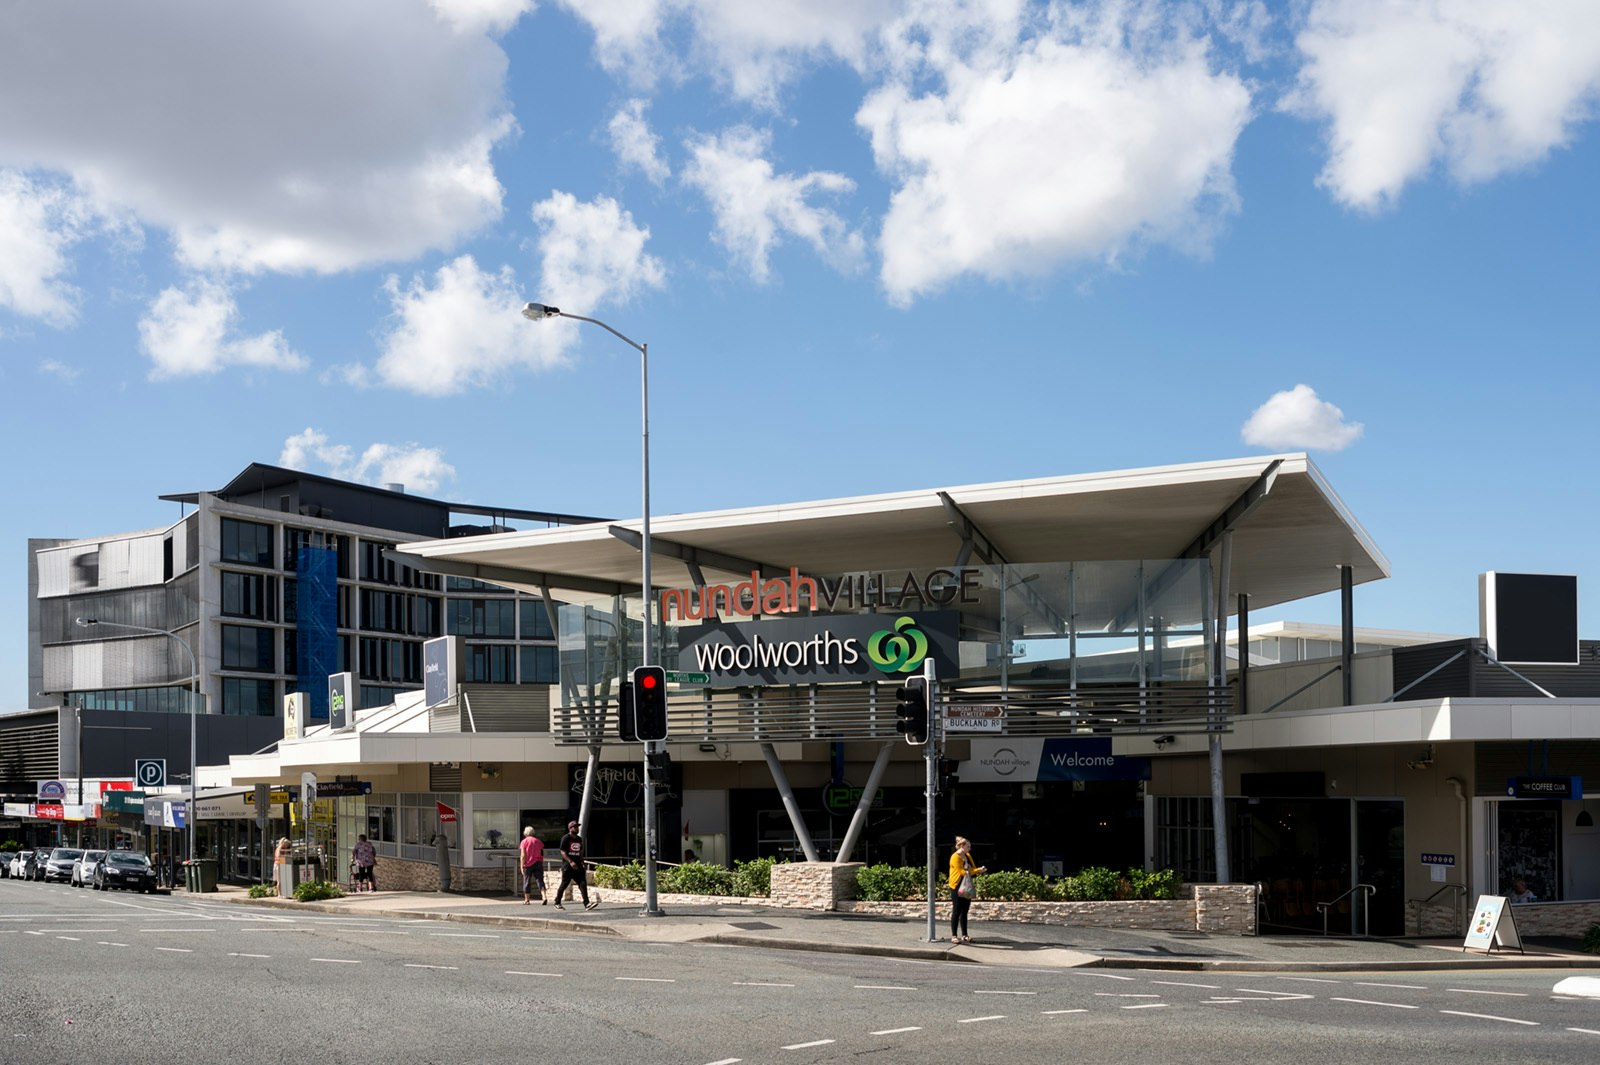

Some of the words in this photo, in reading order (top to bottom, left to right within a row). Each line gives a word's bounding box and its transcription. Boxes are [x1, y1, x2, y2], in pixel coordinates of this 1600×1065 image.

[661, 566, 818, 622] nundah
[819, 568, 981, 612] VILLAGE
[950, 719, 988, 727] BUCKLAND
[1050, 751, 1115, 767] Welcome
[1531, 782, 1553, 791] COFFEE
